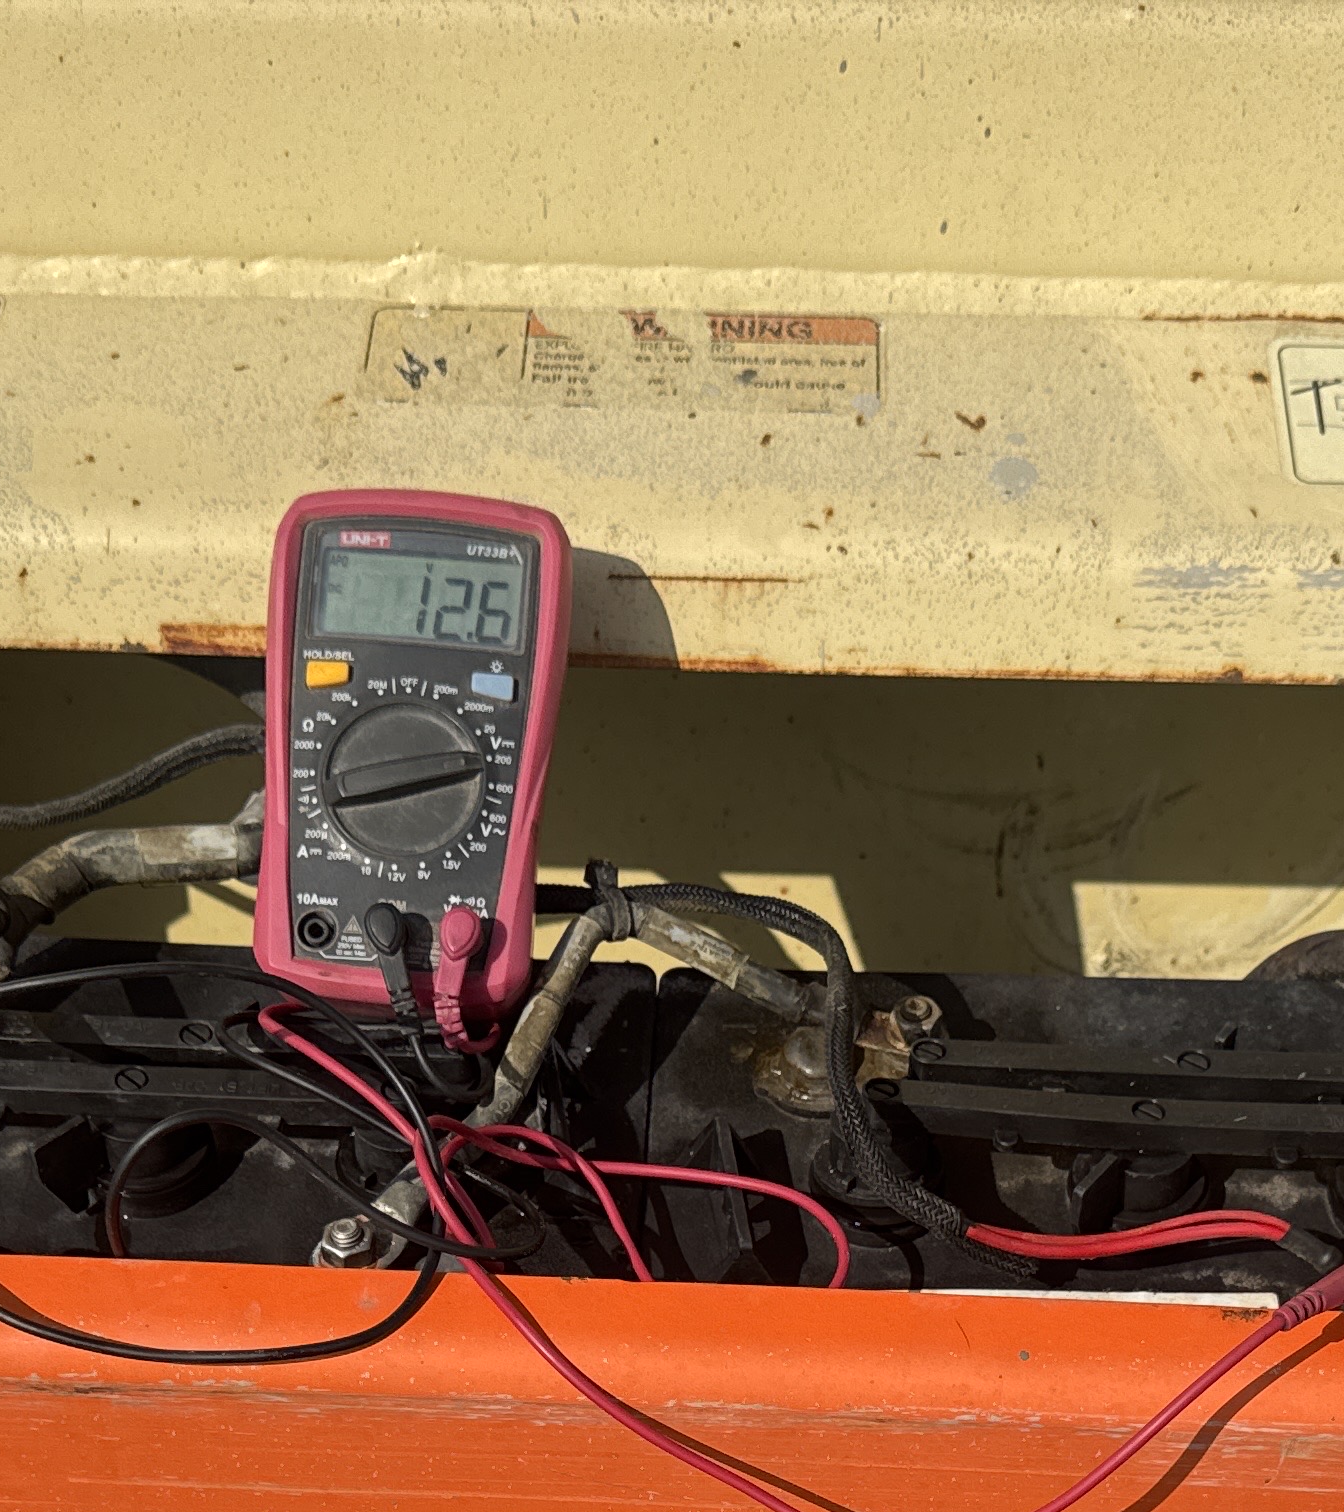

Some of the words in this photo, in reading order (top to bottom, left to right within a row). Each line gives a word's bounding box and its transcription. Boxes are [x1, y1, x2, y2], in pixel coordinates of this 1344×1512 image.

[340, 532, 389, 547] UNI-T
[415, 575, 512, 644] 12.6
[303, 648, 355, 662] HOLD/SEL
[367, 679, 388, 690] 20M
[400, 677, 419, 688] OFF
[433, 684, 459, 695] 200m
[464, 701, 495, 714] 2000m
[483, 724, 496, 735] 20
[293, 740, 315, 750] 2000
[494, 755, 513, 766] 200
[292, 769, 309, 779] 200
[469, 842, 487, 853] 200
[327, 851, 352, 861] 200m
[360, 865, 372, 876] 10
[387, 872, 407, 883] 12V
